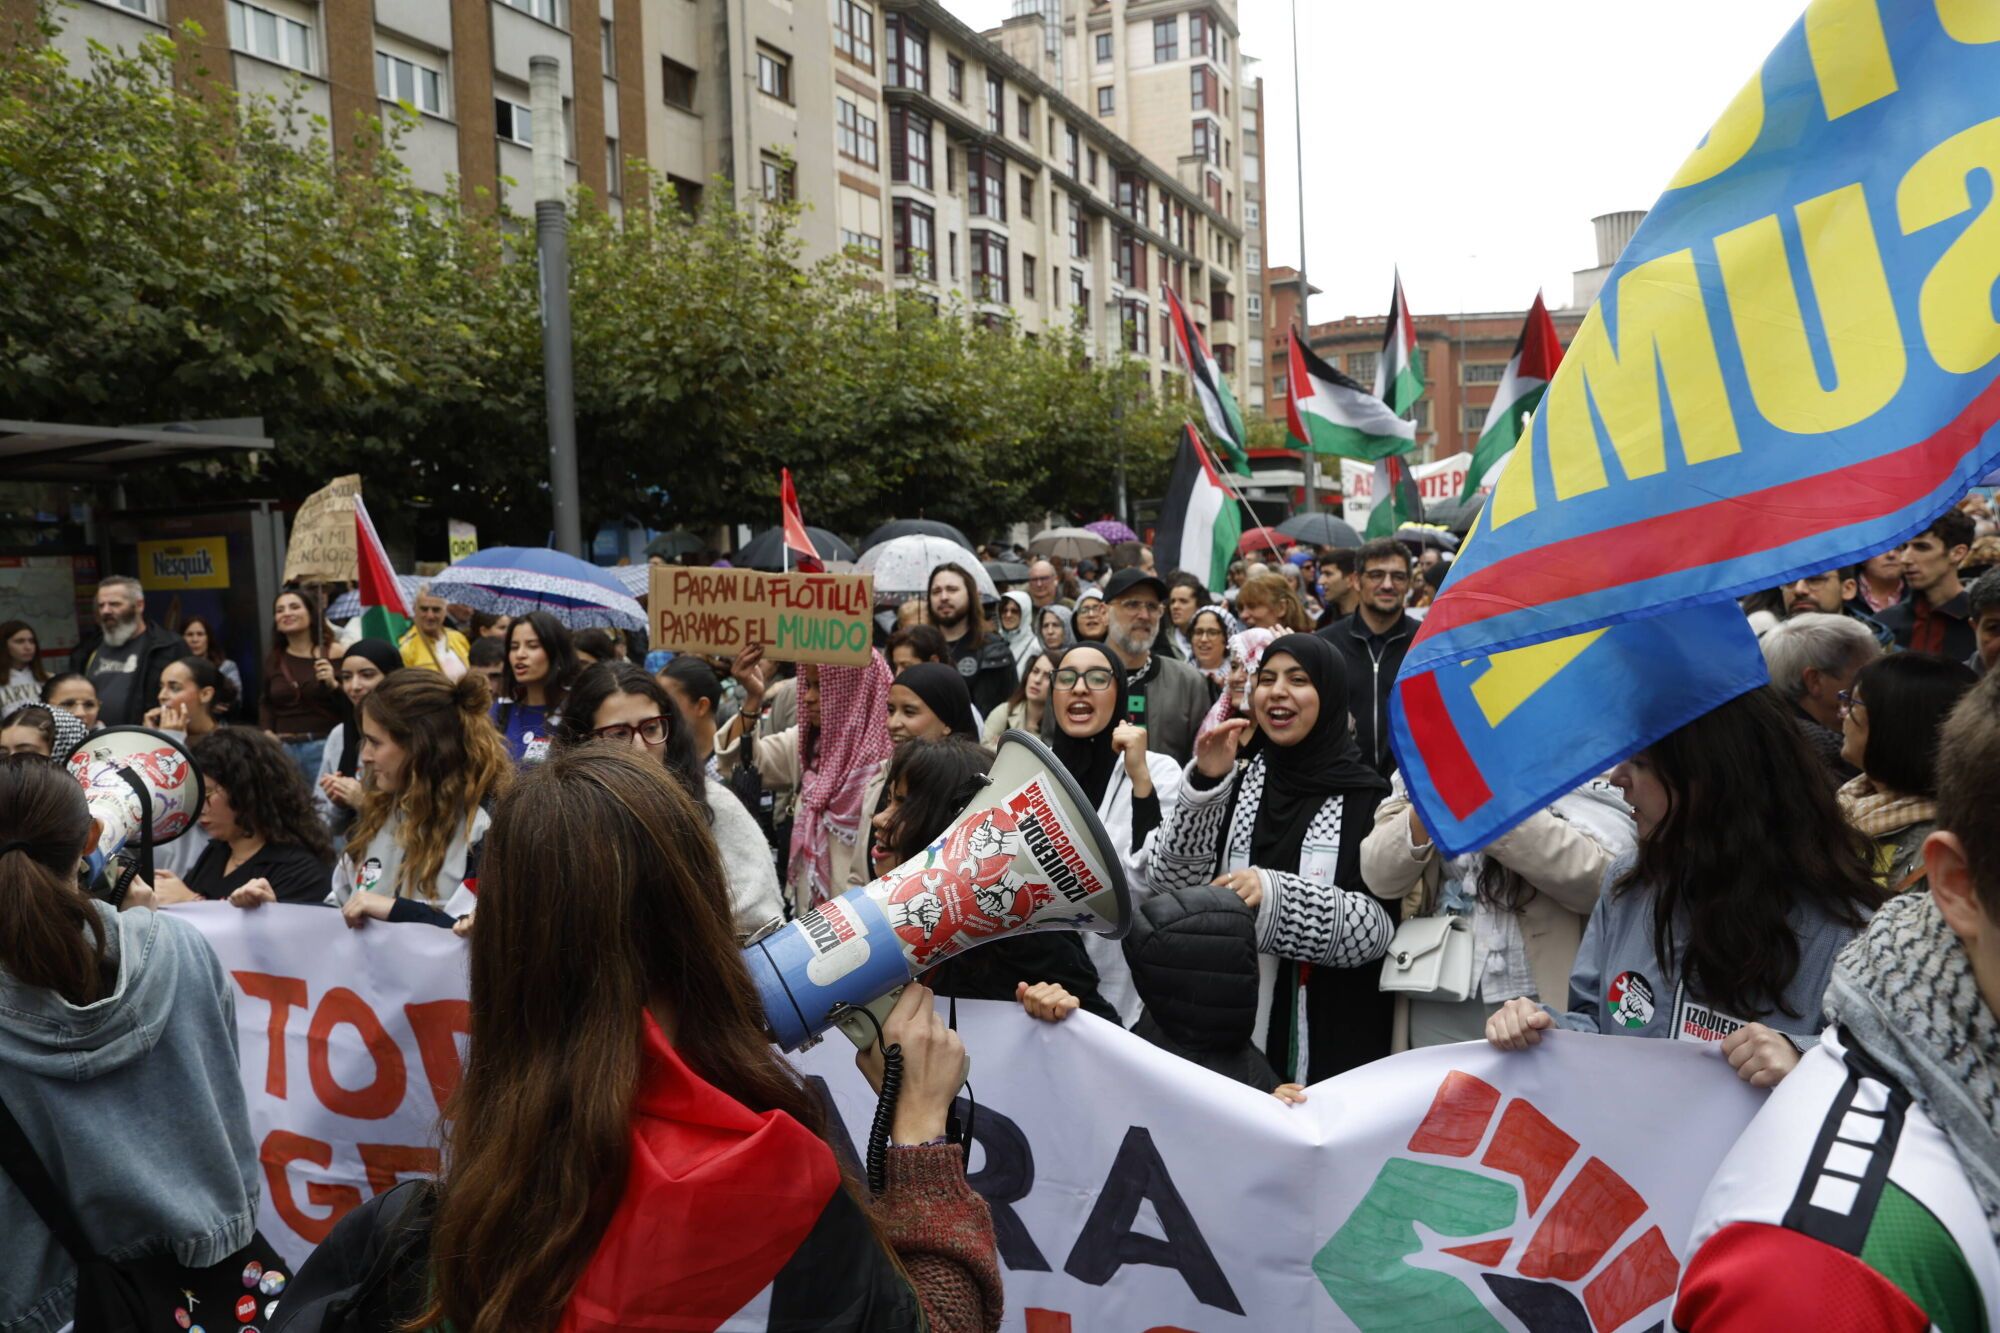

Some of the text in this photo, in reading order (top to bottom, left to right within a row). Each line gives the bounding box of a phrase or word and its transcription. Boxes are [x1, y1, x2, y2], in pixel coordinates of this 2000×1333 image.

[153, 548, 214, 582] Nesquik
[673, 571, 868, 615] PARAN LA FLOTILLA
[660, 610, 867, 653] PARAMOS EL MUNDO
[1018, 812, 1089, 903] IZQUIERDA
[1025, 781, 1103, 894] REVOLUCIONARIA
[943, 886, 957, 924] Estudiantes
[1684, 1021, 1727, 1041] REVOLU
[1685, 1006, 1745, 1036] IZQUIER
